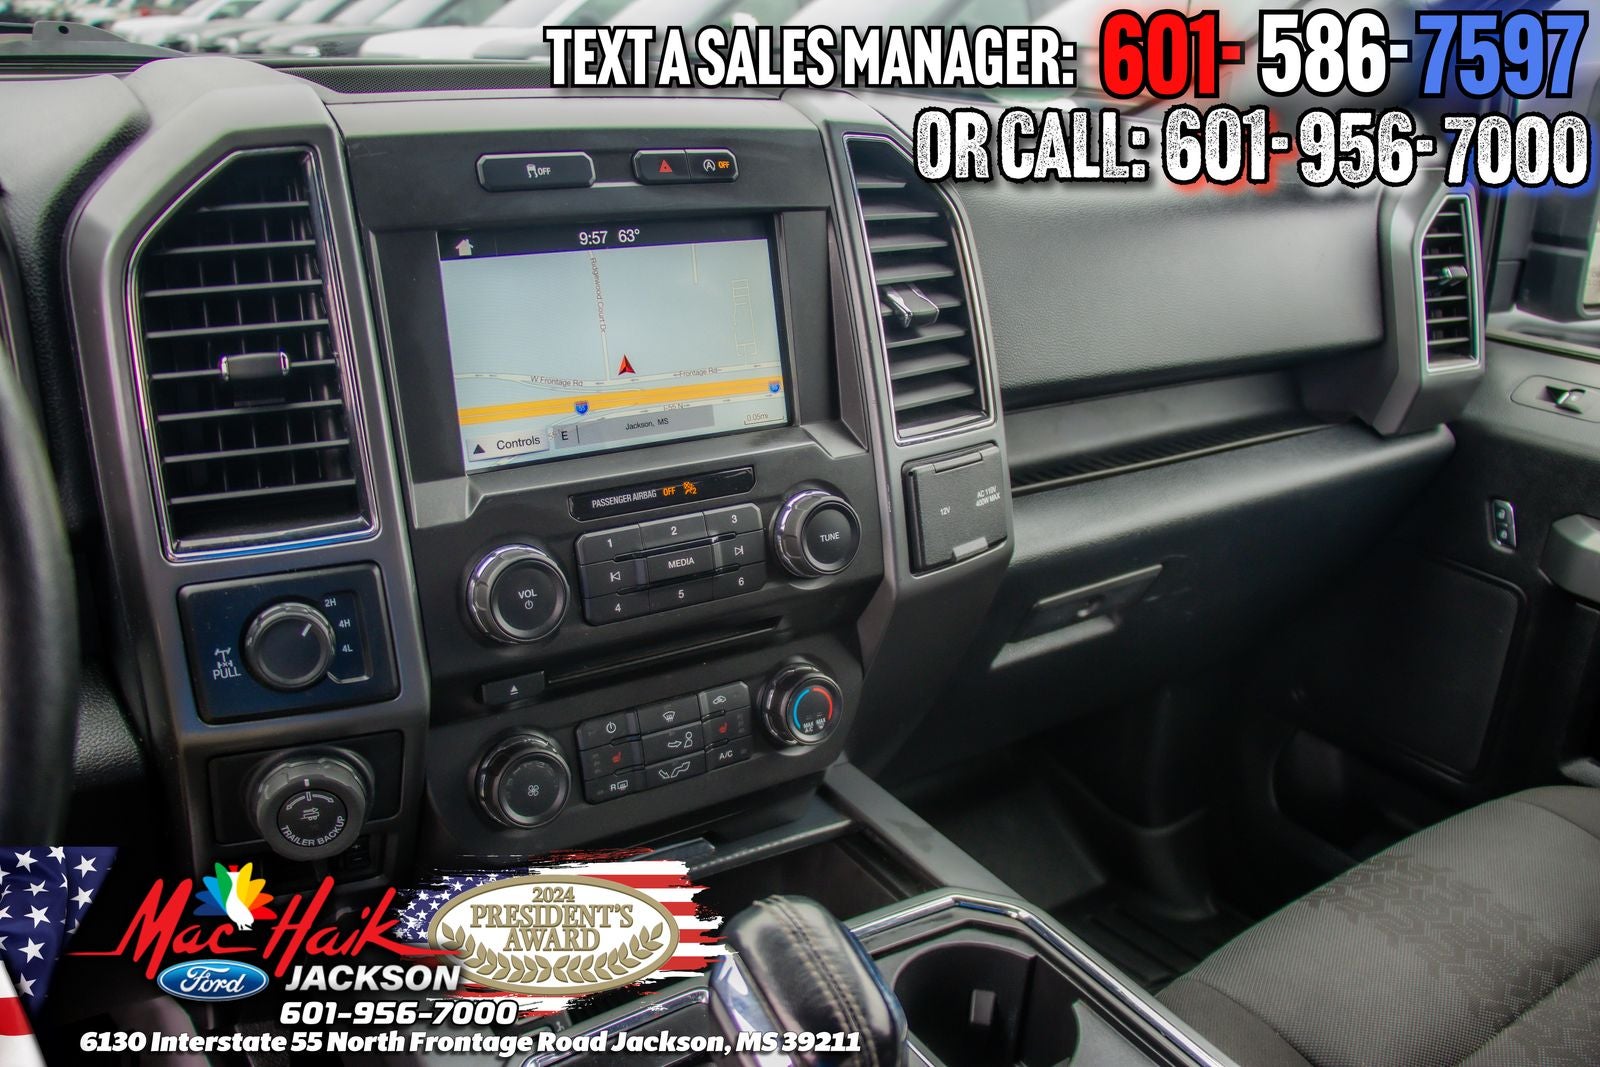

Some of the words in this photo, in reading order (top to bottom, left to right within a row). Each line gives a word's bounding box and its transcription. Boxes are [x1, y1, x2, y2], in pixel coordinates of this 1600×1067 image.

[717, 161, 730, 169] OFF
[537, 167, 551, 176] OFF
[579, 231, 608, 245] 9:57
[618, 229, 640, 242] 63°
[591, 257, 602, 300] Ridgewood
[597, 301, 605, 322] Court
[679, 368, 707, 377] Frontage
[540, 377, 571, 387] Frontage
[625, 419, 654, 430] Jackson,
[657, 417, 669, 426] MS
[561, 430, 568, 440] E
[496, 434, 541, 451] Controls
[591, 493, 632, 509] PASSENGER
[632, 489, 657, 502] AIRBAG
[662, 487, 676, 496] OFF
[940, 505, 950, 516] 12V
[731, 514, 738, 524] 3
[670, 526, 678, 536] 2
[819, 531, 841, 543] TUNE
[606, 538, 612, 548] 1
[667, 556, 695, 570] MEDIA
[738, 576, 745, 586] 6
[518, 588, 538, 600] VOL
[678, 589, 685, 599] 5
[324, 598, 337, 608] 2H
[614, 603, 621, 613] 4
[338, 619, 351, 629] 4H
[342, 644, 353, 653] 4L
[212, 666, 242, 680] PULL
[719, 750, 734, 760] A/C
[281, 825, 316, 847] TRAILER
[316, 815, 345, 846] BACKUP
